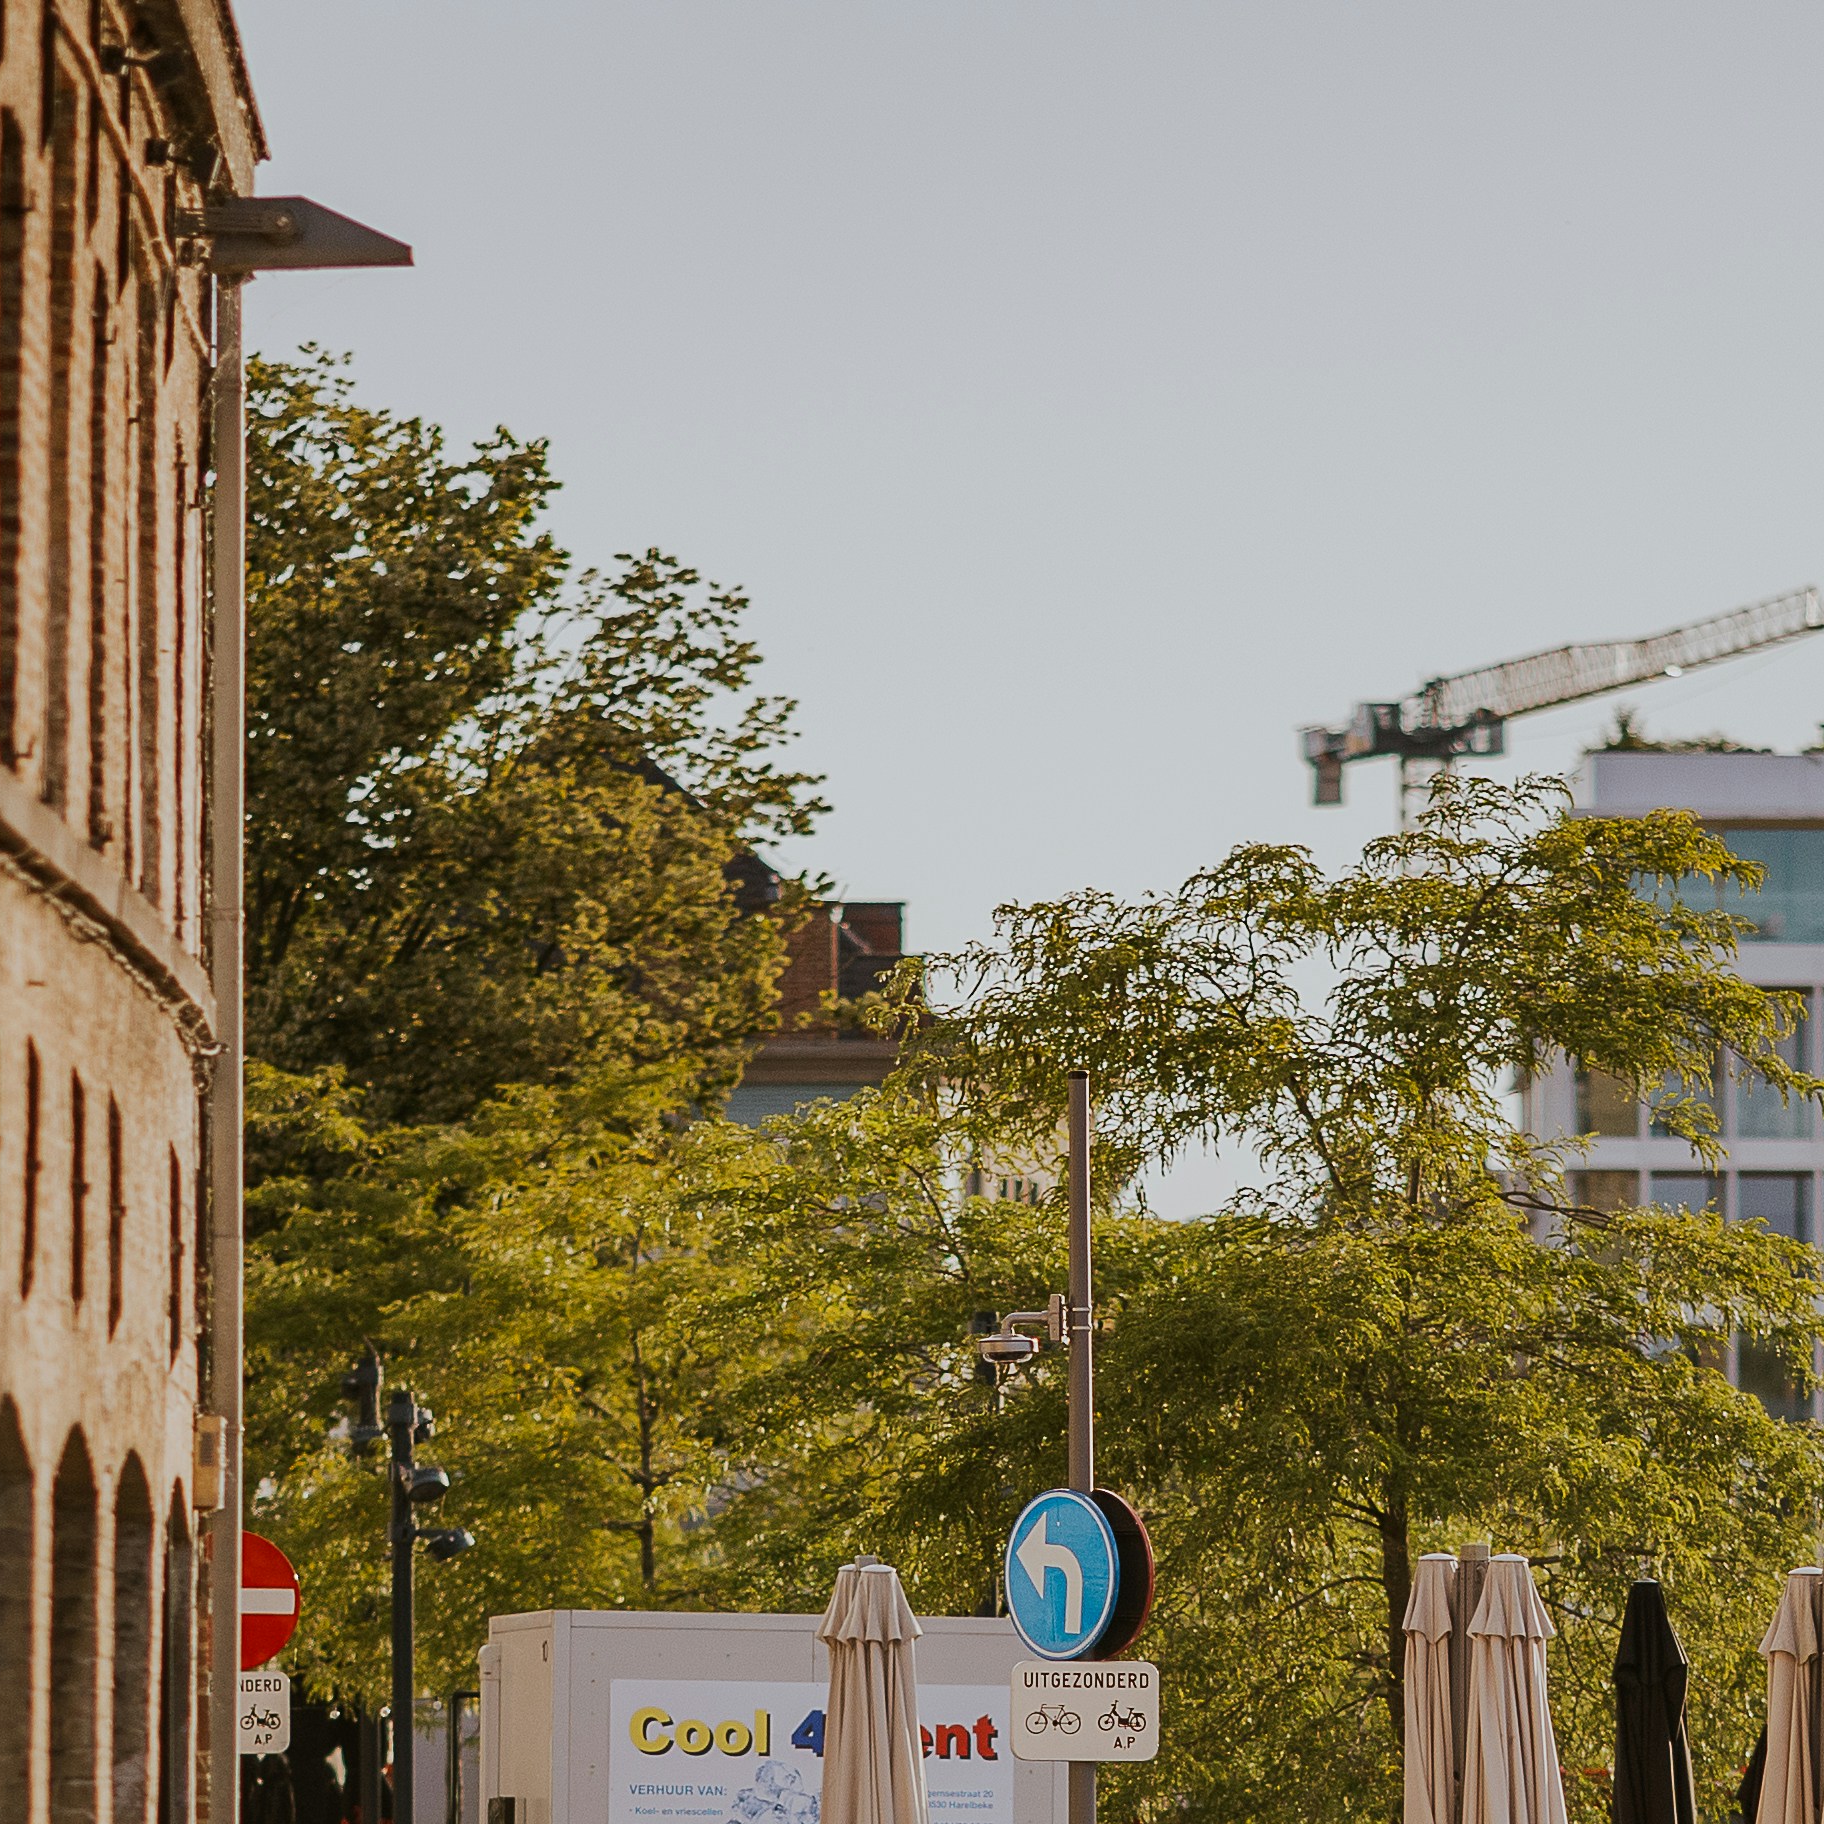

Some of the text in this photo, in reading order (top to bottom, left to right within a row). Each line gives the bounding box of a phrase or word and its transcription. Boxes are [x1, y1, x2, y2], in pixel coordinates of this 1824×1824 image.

[1023, 1671, 1150, 1689] UITGEZONDERD
[628, 1705, 771, 1757] Cool
[629, 1784, 728, 1797] VERHUUR VAN:
[983, 1789, 994, 1798] 20
[949, 1800, 994, 1809] Harelbeke
[634, 1806, 724, 1817] Koel- en vriescellen
